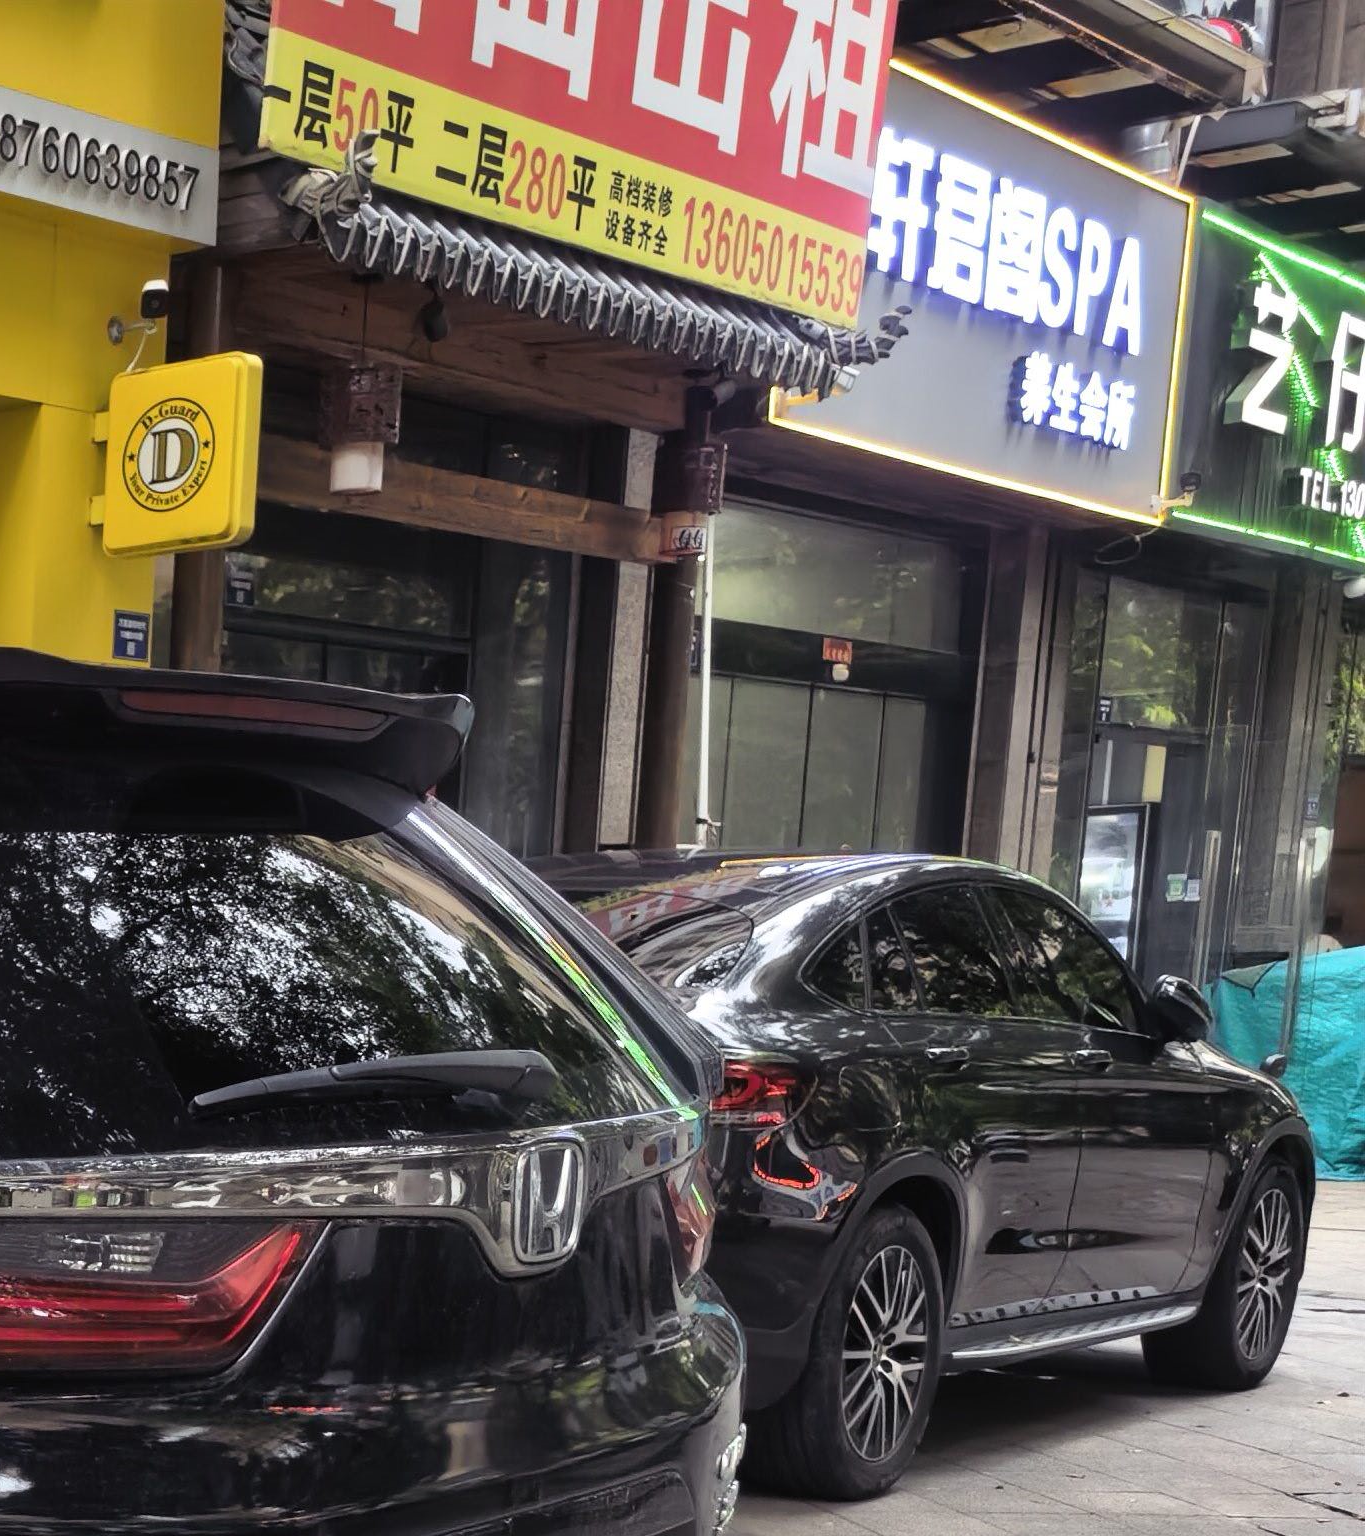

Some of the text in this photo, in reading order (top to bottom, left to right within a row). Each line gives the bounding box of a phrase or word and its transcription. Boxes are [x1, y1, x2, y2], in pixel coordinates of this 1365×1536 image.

[309, 0, 873, 198] 出租
[436, 123, 597, 232] 二层280平
[609, 170, 673, 218] 高档装修
[605, 209, 669, 256] 设备齐全
[683, 196, 863, 317] 13605015539
[139, 403, 201, 429] D-Guard
[145, 492, 180, 505] Private
[182, 460, 207, 496] Expert
[149, 428, 195, 485] D
